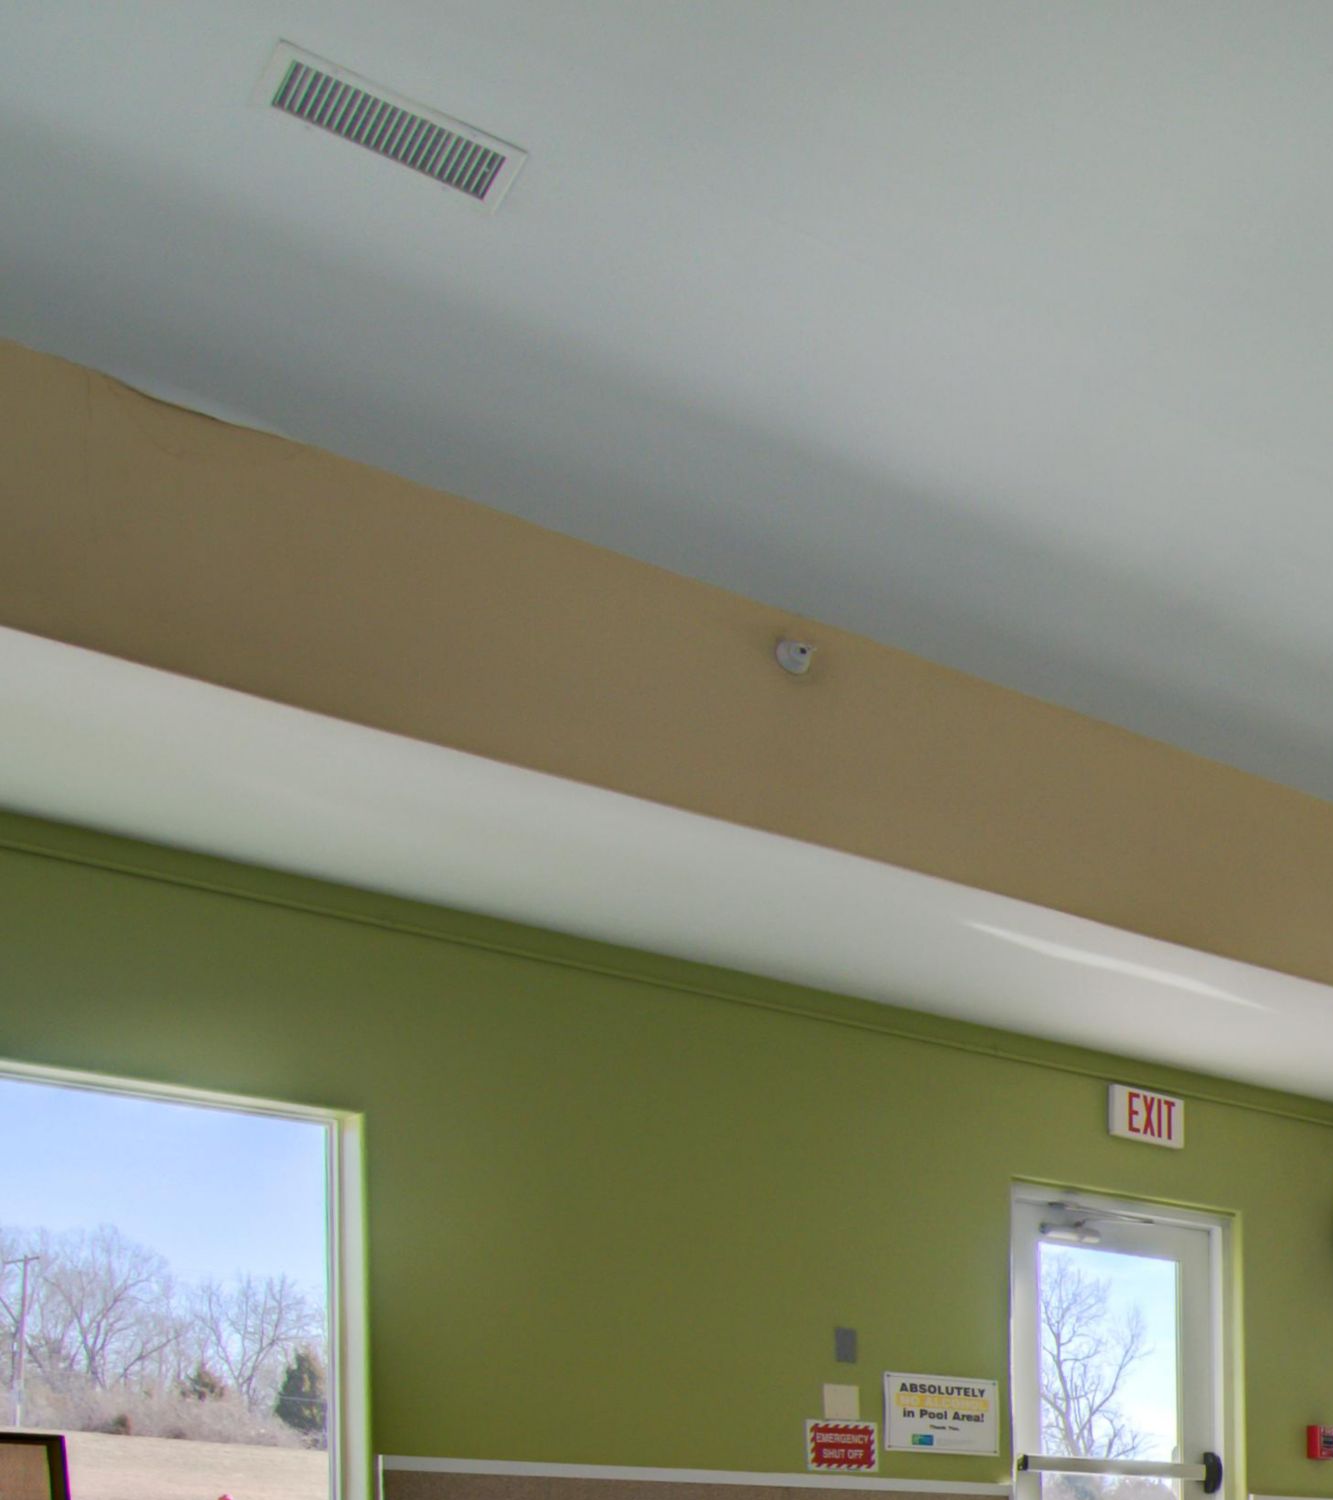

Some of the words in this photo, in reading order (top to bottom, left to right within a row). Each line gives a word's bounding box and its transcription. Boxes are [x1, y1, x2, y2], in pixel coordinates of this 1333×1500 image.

[1127, 1091, 1176, 1141] EXIT
[900, 1382, 986, 1399] ABSOLUTELY
[902, 1407, 916, 1418] in
[919, 1409, 948, 1421] Pool
[952, 1411, 985, 1423] Area!
[816, 1433, 869, 1444] EMERGENCY
[822, 1449, 846, 1459] SHUT
[847, 1449, 865, 1459] OFF
